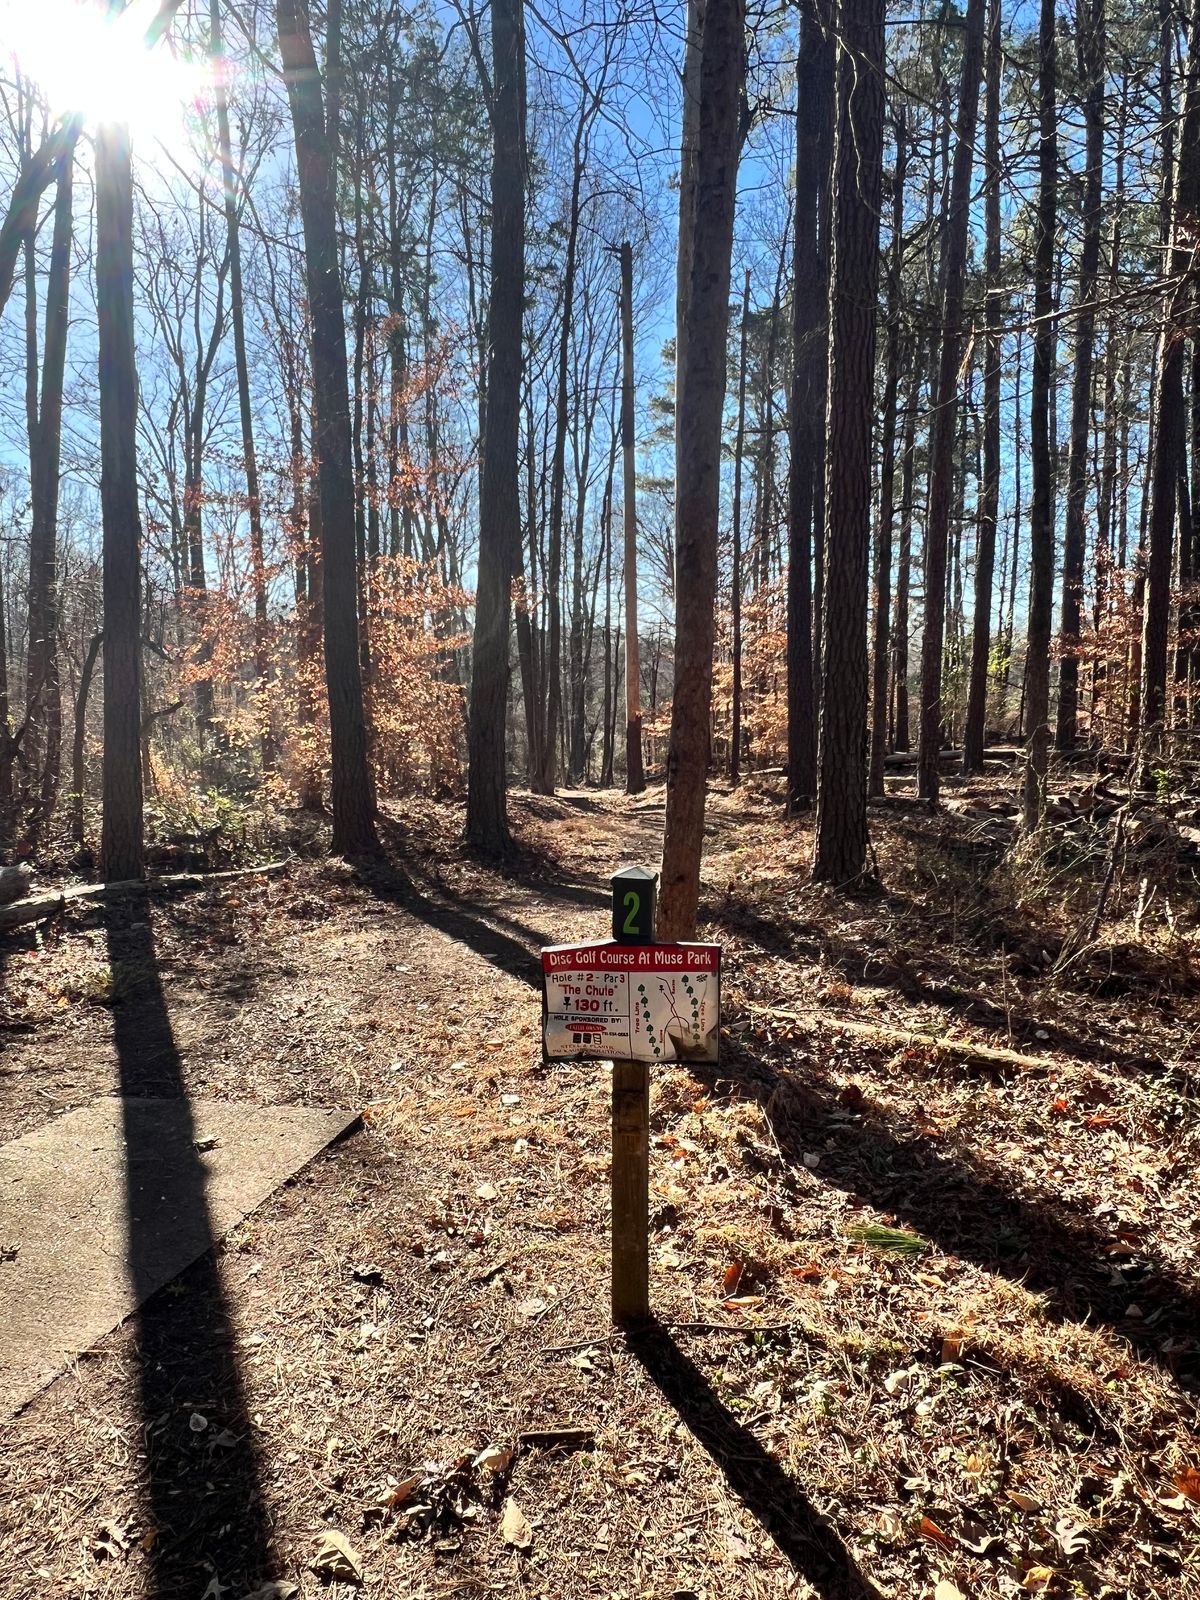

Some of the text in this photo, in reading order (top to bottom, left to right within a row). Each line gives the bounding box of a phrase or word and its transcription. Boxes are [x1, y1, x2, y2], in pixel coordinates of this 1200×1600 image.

[623, 891, 640, 934] 2
[549, 950, 712, 966] Disc Golf Course At Muse Park
[551, 973, 573, 983] Hole
[575, 999, 619, 1012] 130 ft.
[571, 1015, 608, 1023] SPONSORED
